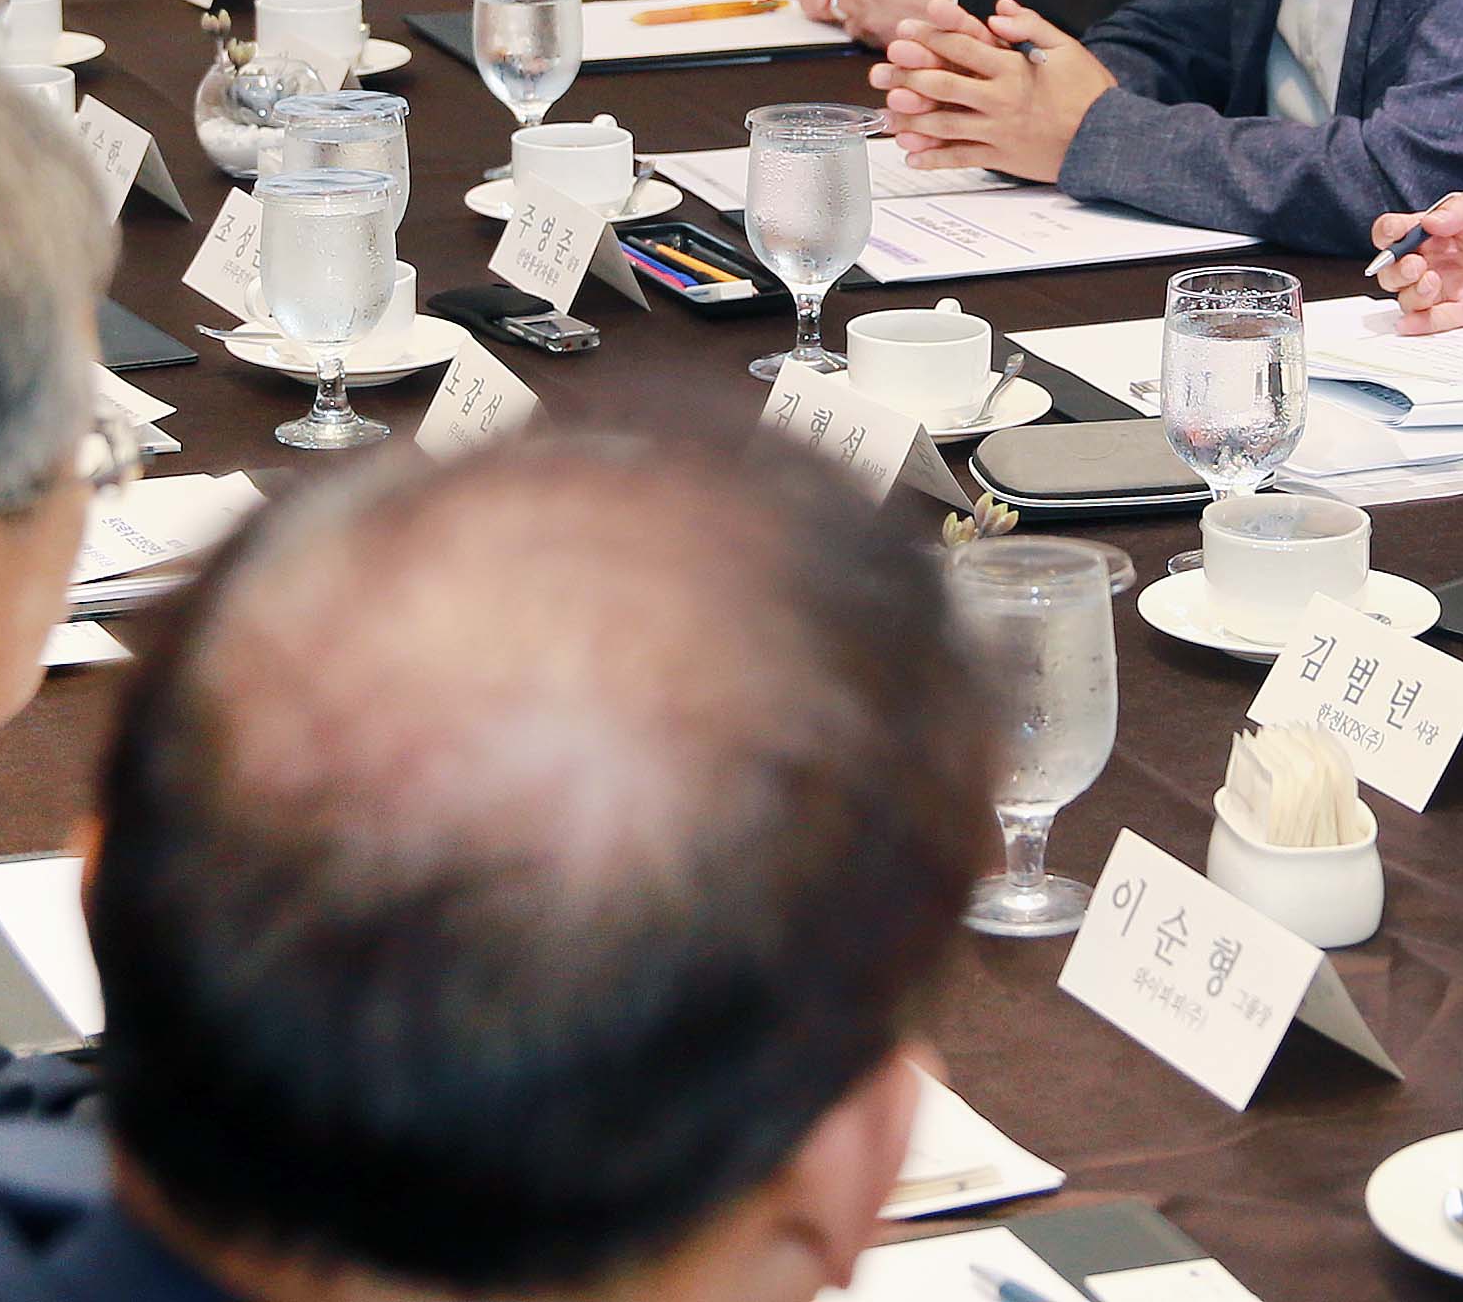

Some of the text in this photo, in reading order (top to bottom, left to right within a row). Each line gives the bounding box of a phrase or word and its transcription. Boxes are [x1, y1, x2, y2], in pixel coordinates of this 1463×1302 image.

[1300, 633, 1439, 746] 김범년 사장
[1316, 702, 1386, 754] 한전KPS(주)
[1112, 877, 1242, 997] 이순형
